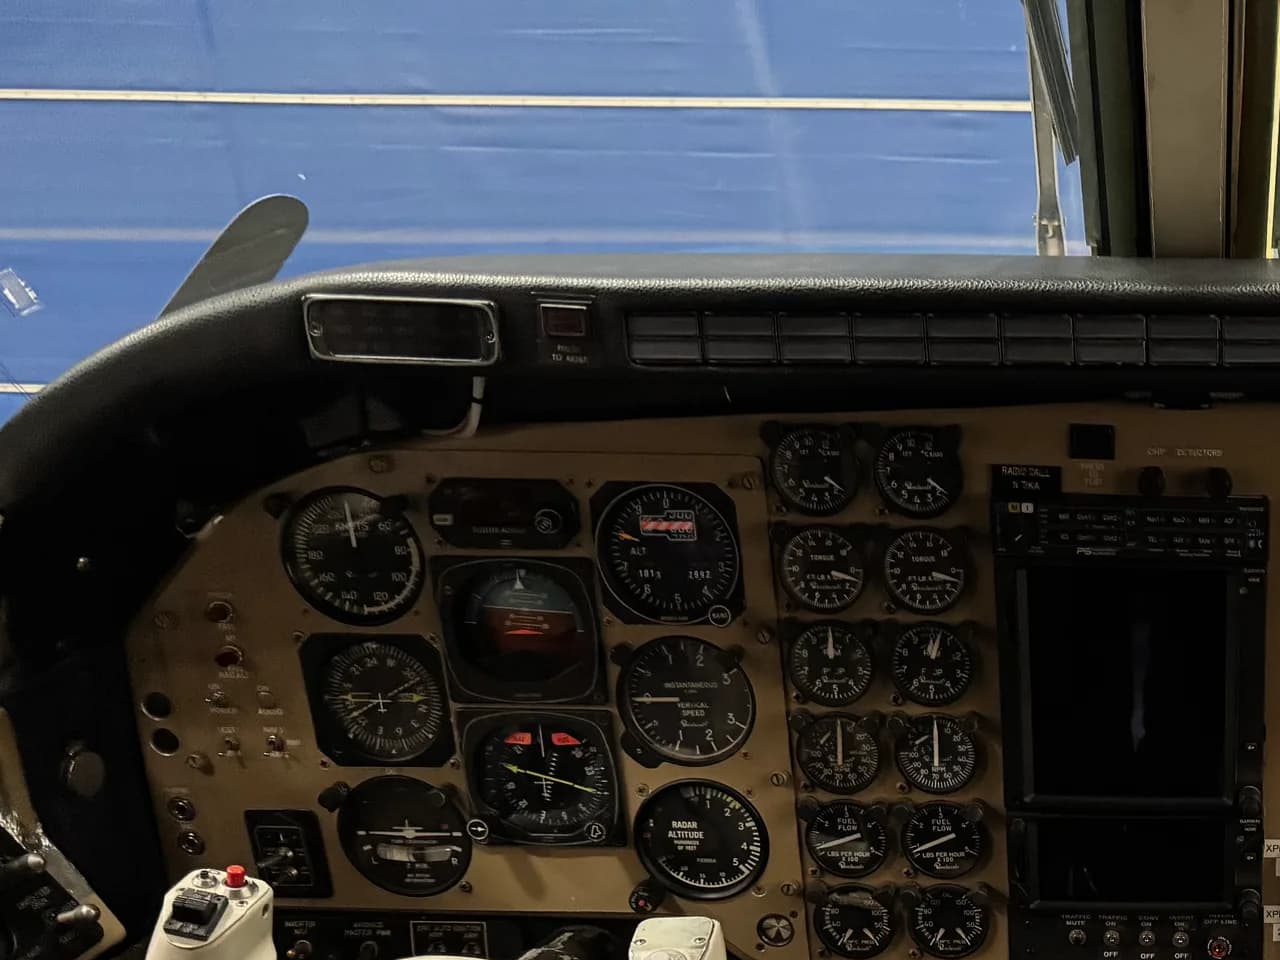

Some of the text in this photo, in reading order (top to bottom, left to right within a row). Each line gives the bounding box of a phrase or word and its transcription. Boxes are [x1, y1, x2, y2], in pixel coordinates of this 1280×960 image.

[671, 820, 699, 829] RADAR
[667, 830, 705, 840] ALTITUDE
[1104, 951, 1119, 959] OFF
[1140, 952, 1156, 960] OFF
